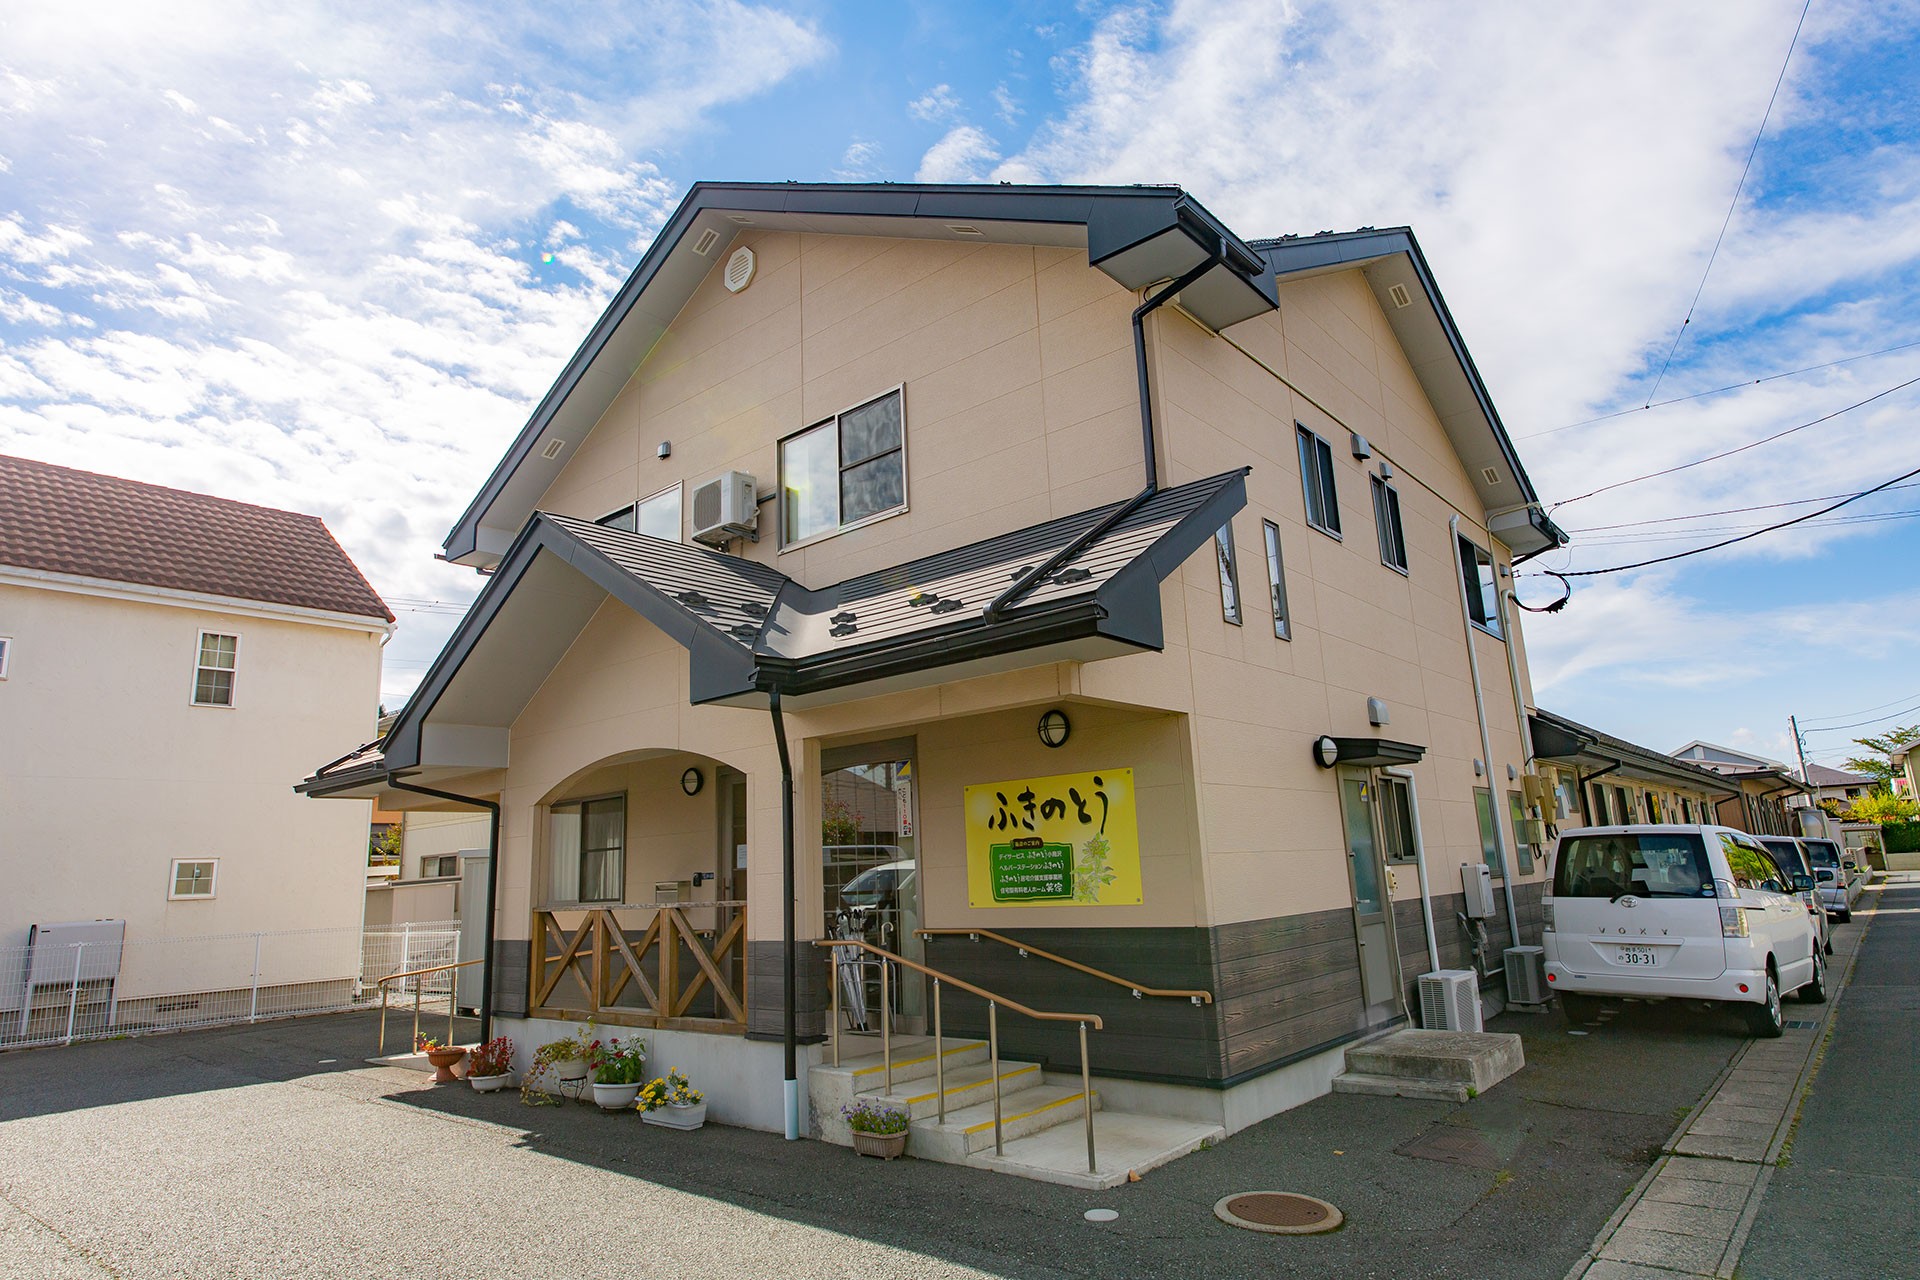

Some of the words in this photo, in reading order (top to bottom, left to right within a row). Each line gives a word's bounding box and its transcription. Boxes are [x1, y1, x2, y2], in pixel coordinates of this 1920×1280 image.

[988, 775, 1109, 835] ふきのとう
[1598, 926, 1668, 936] VOXY
[1625, 953, 1655, 965] 30-31
